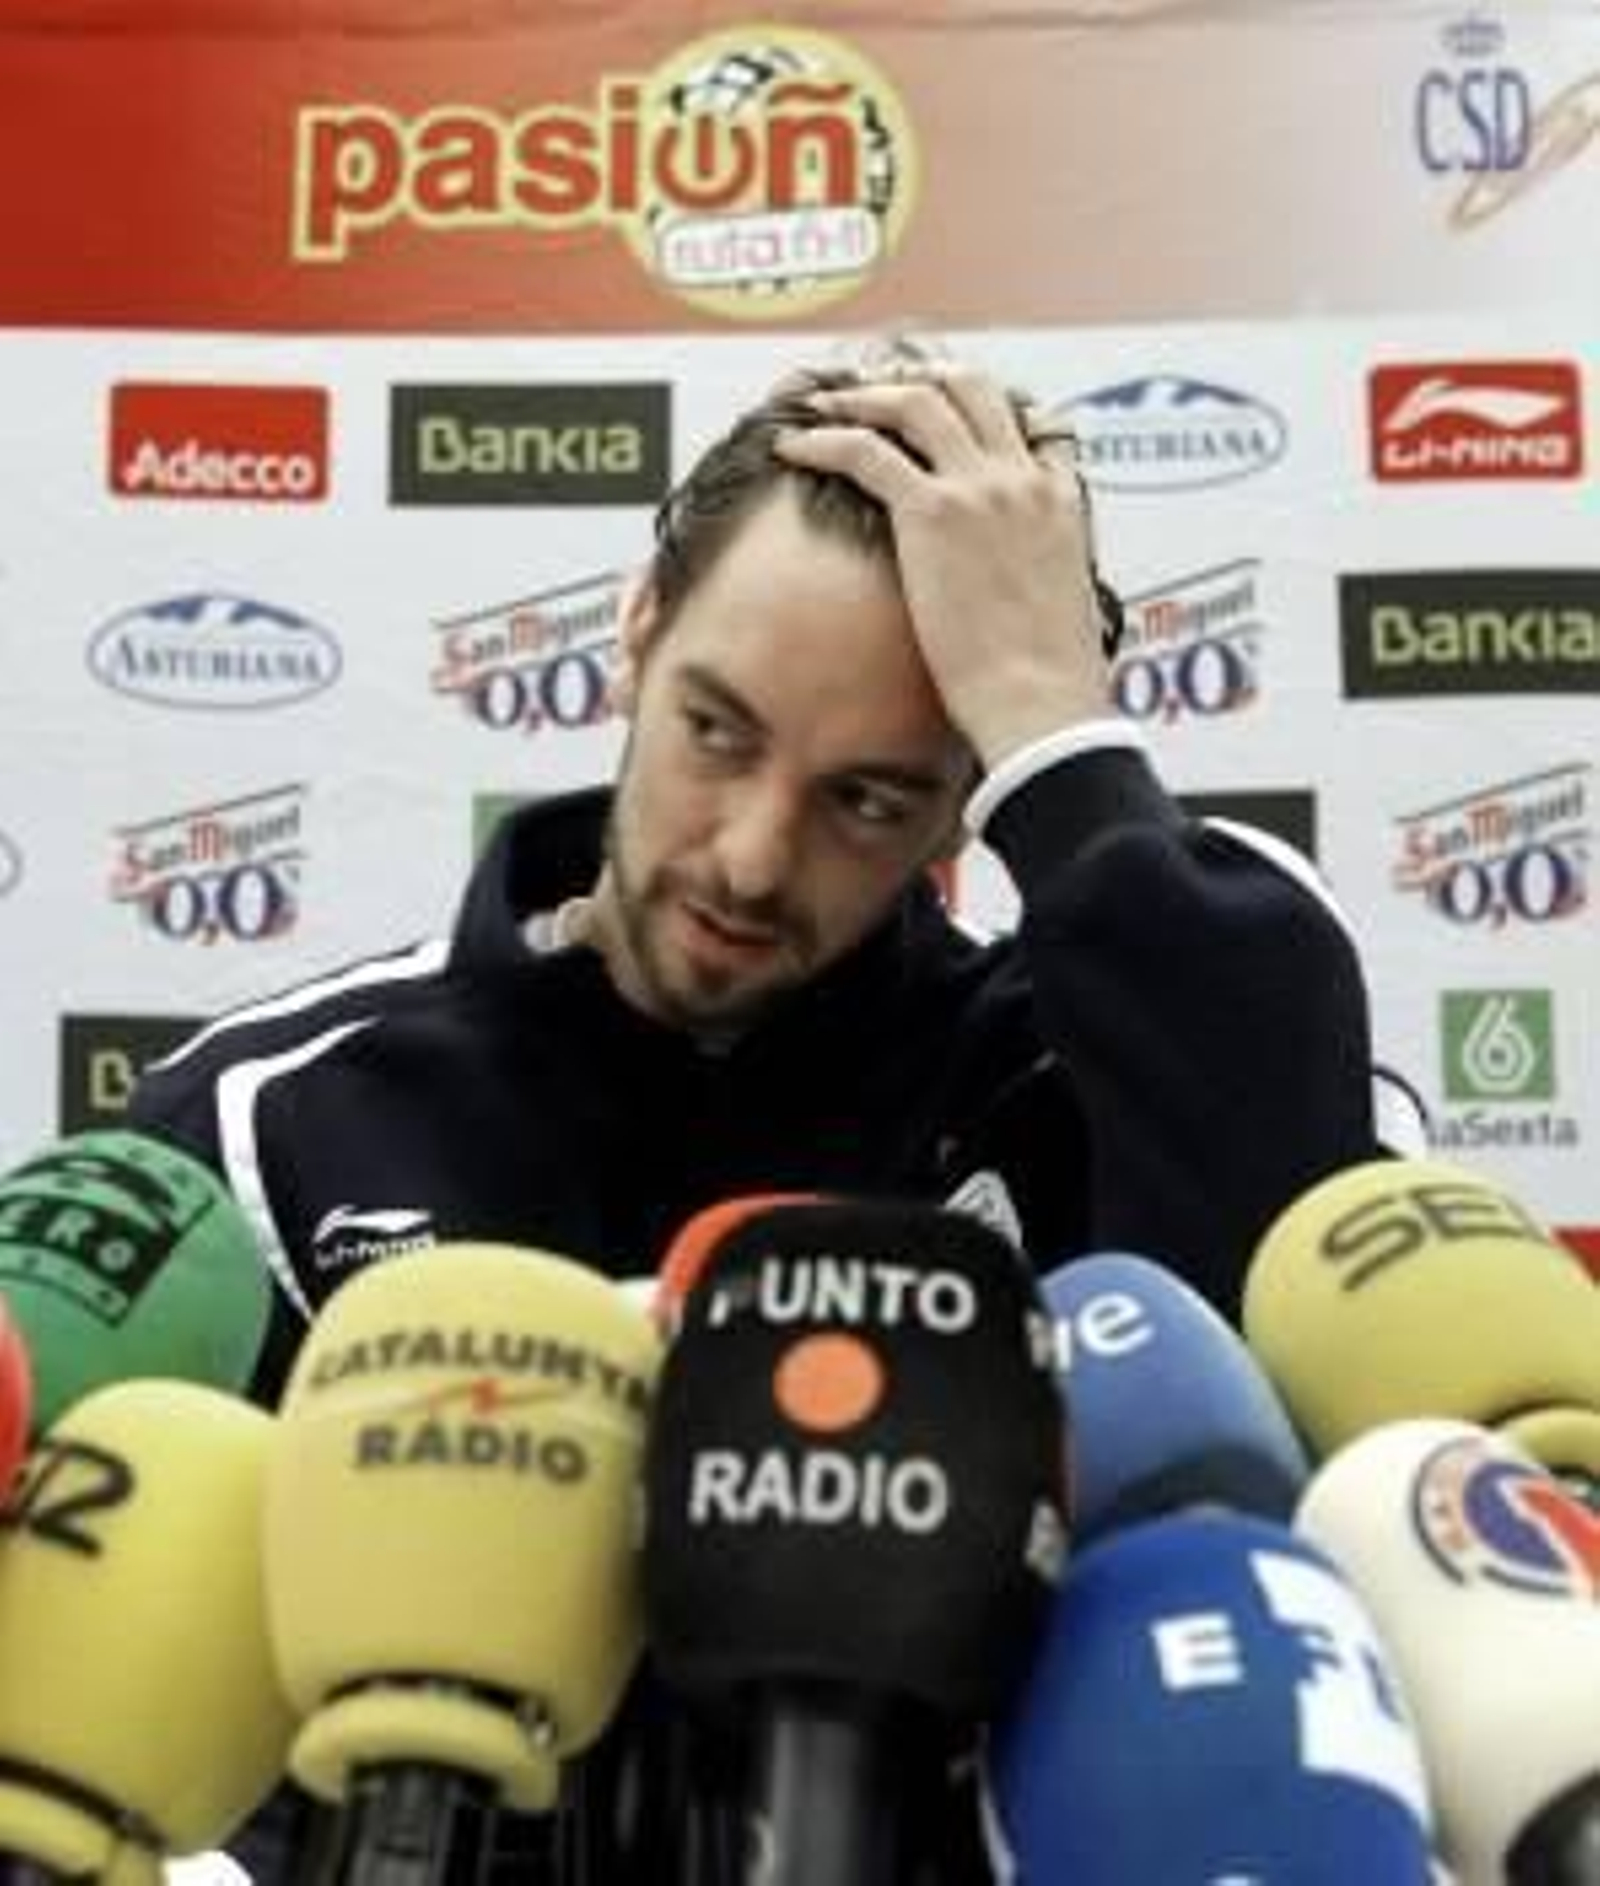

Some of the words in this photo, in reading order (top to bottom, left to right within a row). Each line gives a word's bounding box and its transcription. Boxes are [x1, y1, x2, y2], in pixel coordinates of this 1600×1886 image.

[1416, 70, 1530, 172] CSD
[126, 441, 315, 495] Adecco
[418, 418, 642, 473] Bankia
[1078, 430, 1266, 463] STURIANA
[1372, 605, 1600, 664] Bankia
[689, 1448, 951, 1534] RADIO
